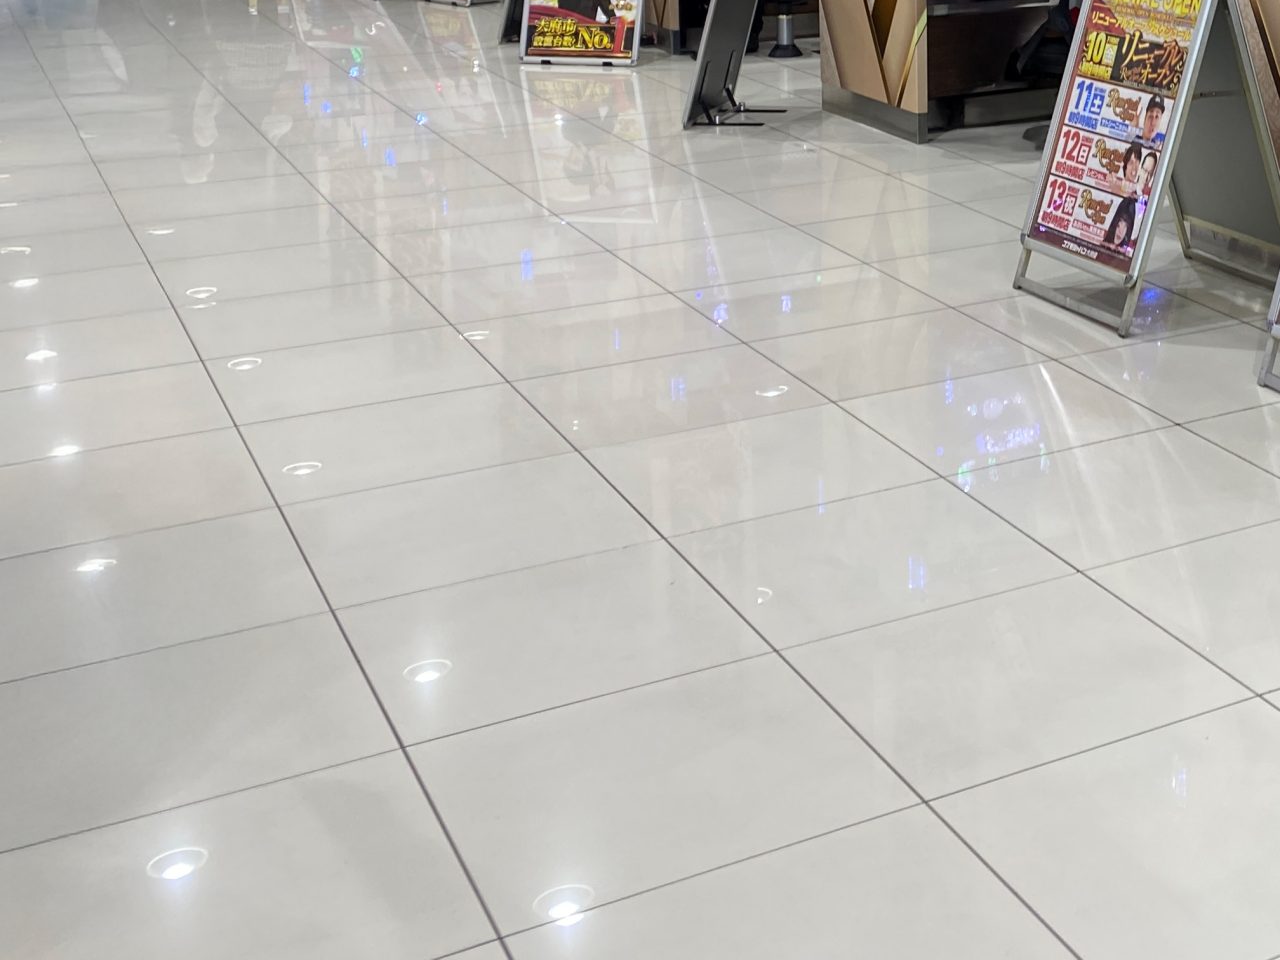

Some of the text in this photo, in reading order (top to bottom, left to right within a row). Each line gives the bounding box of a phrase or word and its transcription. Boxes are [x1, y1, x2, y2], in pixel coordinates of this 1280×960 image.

[535, 17, 577, 35] 大府市
[1084, 32, 1107, 62] 10
[1119, 30, 1185, 75] リニューアル
[1140, 64, 1173, 88] オープン
[1072, 81, 1102, 113] 11 土
[1059, 129, 1089, 162] 12 日
[1045, 179, 1067, 210] 13
